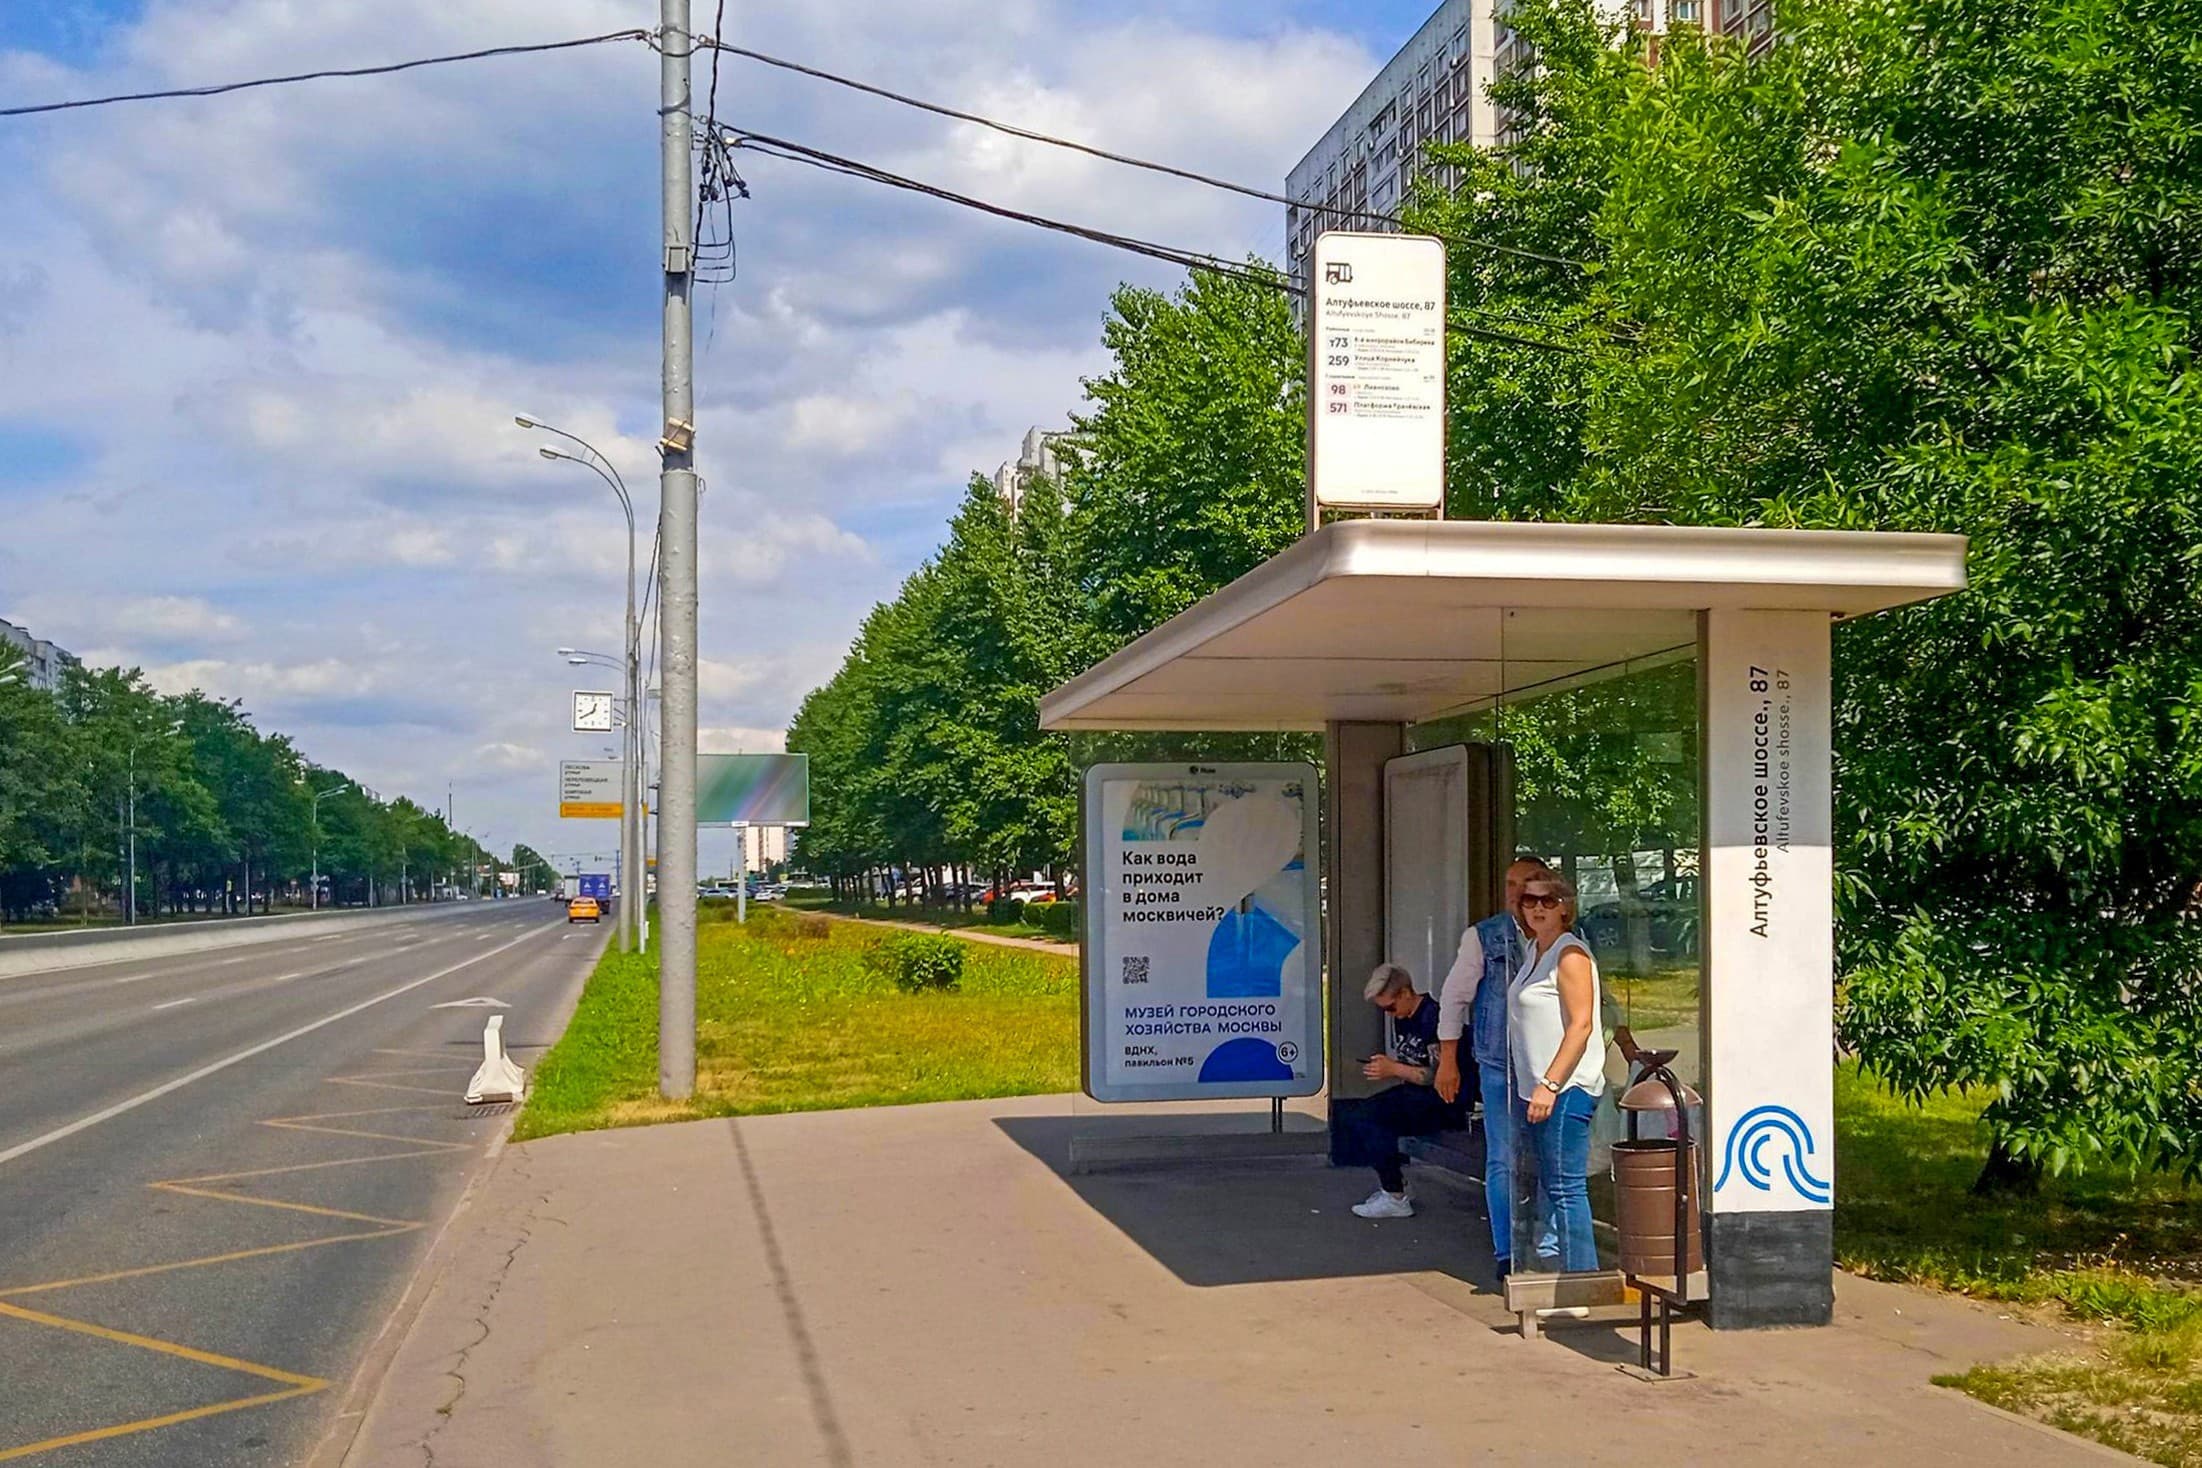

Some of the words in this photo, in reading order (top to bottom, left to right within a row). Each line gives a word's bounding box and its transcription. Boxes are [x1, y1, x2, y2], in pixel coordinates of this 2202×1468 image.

[1325, 297, 1391, 309] Алтуфьевское
[1392, 301, 1423, 311] шоссе,
[1424, 301, 1436, 311] 87
[1328, 355, 1350, 366] 259
[1330, 384, 1346, 395] 98
[1330, 402, 1347, 413] 571
[1750, 665, 1768, 692] 87
[1776, 669, 1789, 690] 87
[1776, 761, 1790, 853] Altufevskoe
[1122, 851, 1153, 865] Как
[1156, 852, 1197, 867] вода
[1748, 785, 1773, 938] Алтуфьевское
[1122, 871, 1203, 887] приходит
[1123, 892, 1133, 903] в
[1136, 891, 1180, 906] дома
[1123, 906, 1225, 923] москвичей?
[1125, 1004, 1174, 1019] МУЗЕЙ
[1179, 1003, 1276, 1019] ГОРОДСКОГО
[1125, 1021, 1211, 1036] ХОЗЯЙСТВА
[1217, 1020, 1282, 1034] МОСКВЫ
[1124, 1046, 1158, 1057] ВДНХ,
[1281, 1046, 1296, 1057] 6+
[1124, 1058, 1174, 1068] павильон
[1175, 1056, 1194, 1067] №5
